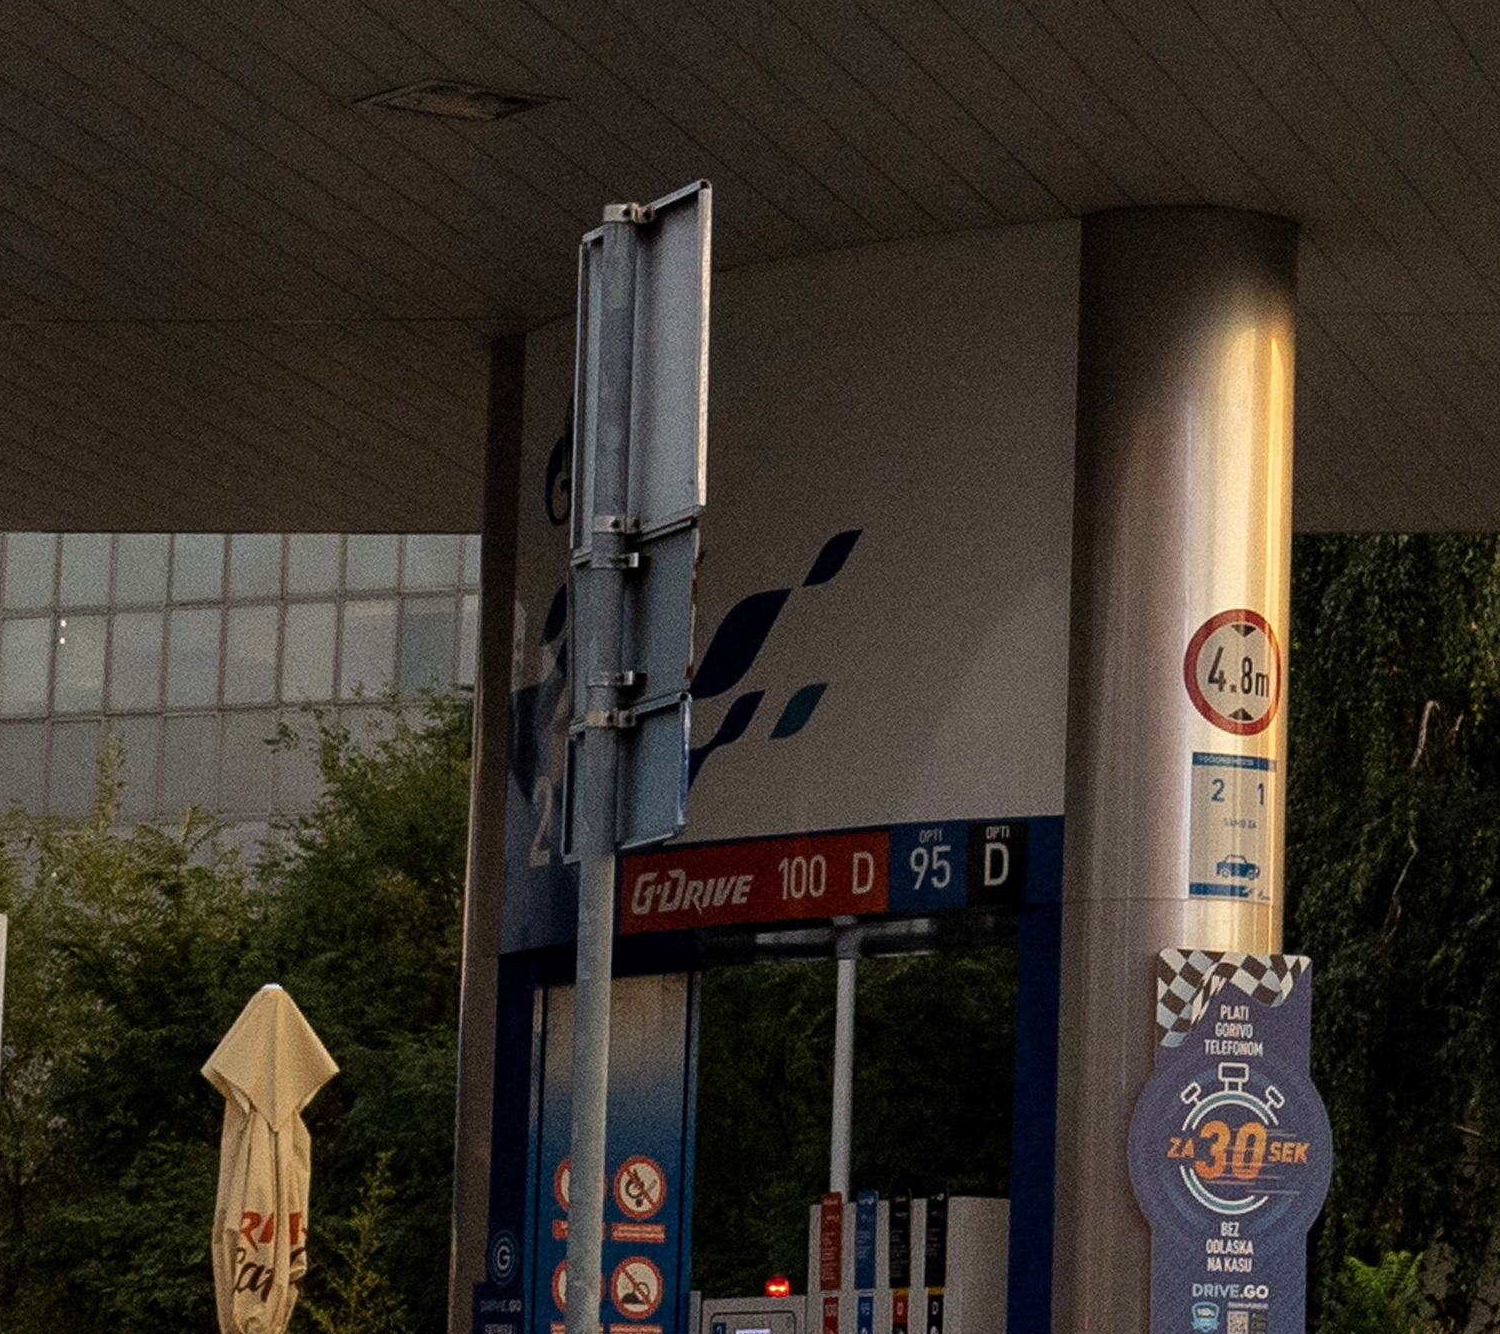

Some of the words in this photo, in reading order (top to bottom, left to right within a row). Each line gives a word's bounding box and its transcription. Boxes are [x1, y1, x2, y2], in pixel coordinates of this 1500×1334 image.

[1210, 778, 1225, 803] 2
[1256, 782, 1264, 806] 1
[918, 828, 945, 844] OPTI
[984, 825, 1011, 839] OPTI
[909, 844, 952, 891] 95
[983, 843, 1010, 888] D
[778, 854, 827, 901] 100
[851, 851, 876, 896] D
[1220, 1004, 1250, 1021] PLATI
[1214, 1022, 1254, 1039] GORIVO
[1203, 1039, 1264, 1057] TELEFONOM
[1166, 1136, 1196, 1159] ZA
[1194, 1120, 1268, 1179] 30
[1267, 1141, 1312, 1164] SEK
[1220, 1221, 1240, 1237] BEZ
[1205, 1238, 1255, 1255] ODLASKA
[1206, 1256, 1222, 1272] NA
[1223, 1257, 1253, 1273] KASU
[1191, 1283, 1269, 1299] DRIVE.GO
